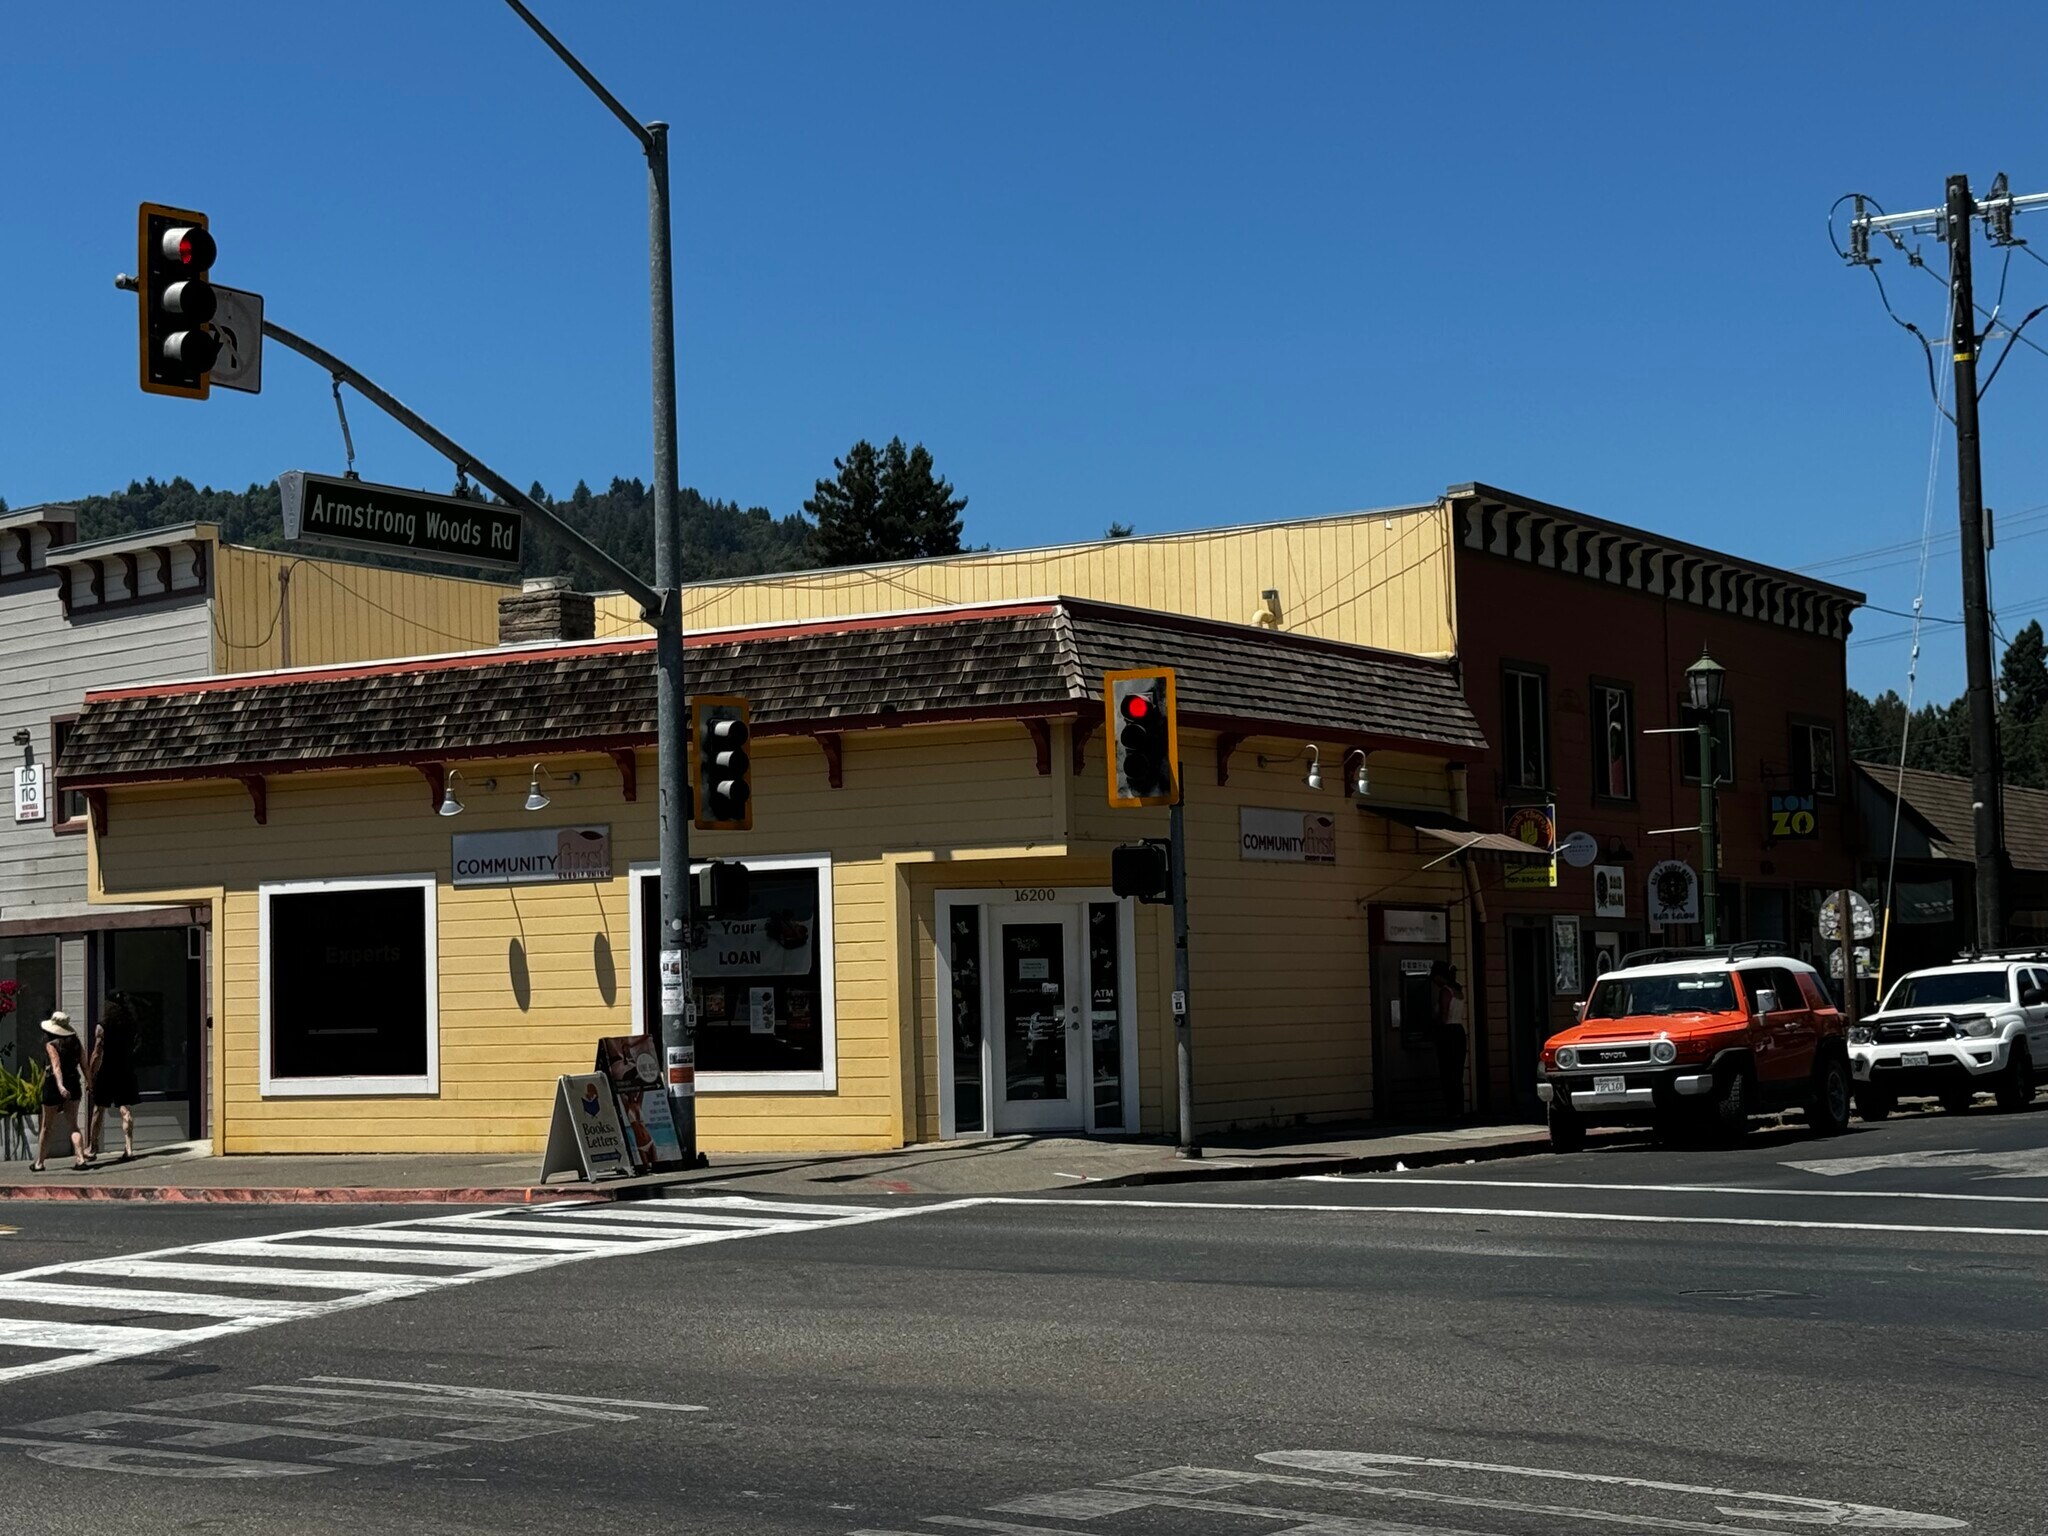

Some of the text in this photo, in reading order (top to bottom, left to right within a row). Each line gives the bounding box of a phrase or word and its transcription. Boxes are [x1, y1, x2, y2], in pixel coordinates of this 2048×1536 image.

[311, 494, 416, 545] Armstrong
[426, 511, 482, 546] Woods
[491, 522, 513, 550] Rd
[1772, 795, 1814, 811] BON
[1772, 811, 1815, 836] ZO
[1243, 827, 1334, 855] COMMUNITY first
[457, 842, 609, 875] COMMUNITY first
[1015, 889, 1056, 902] 16200
[721, 922, 758, 934] Your
[719, 951, 761, 965] LOAN
[1093, 989, 1114, 998] ATM
[1599, 1051, 1628, 1060] TOYOTA
[582, 1121, 611, 1136] Books
[585, 1136, 619, 1149] Letters
